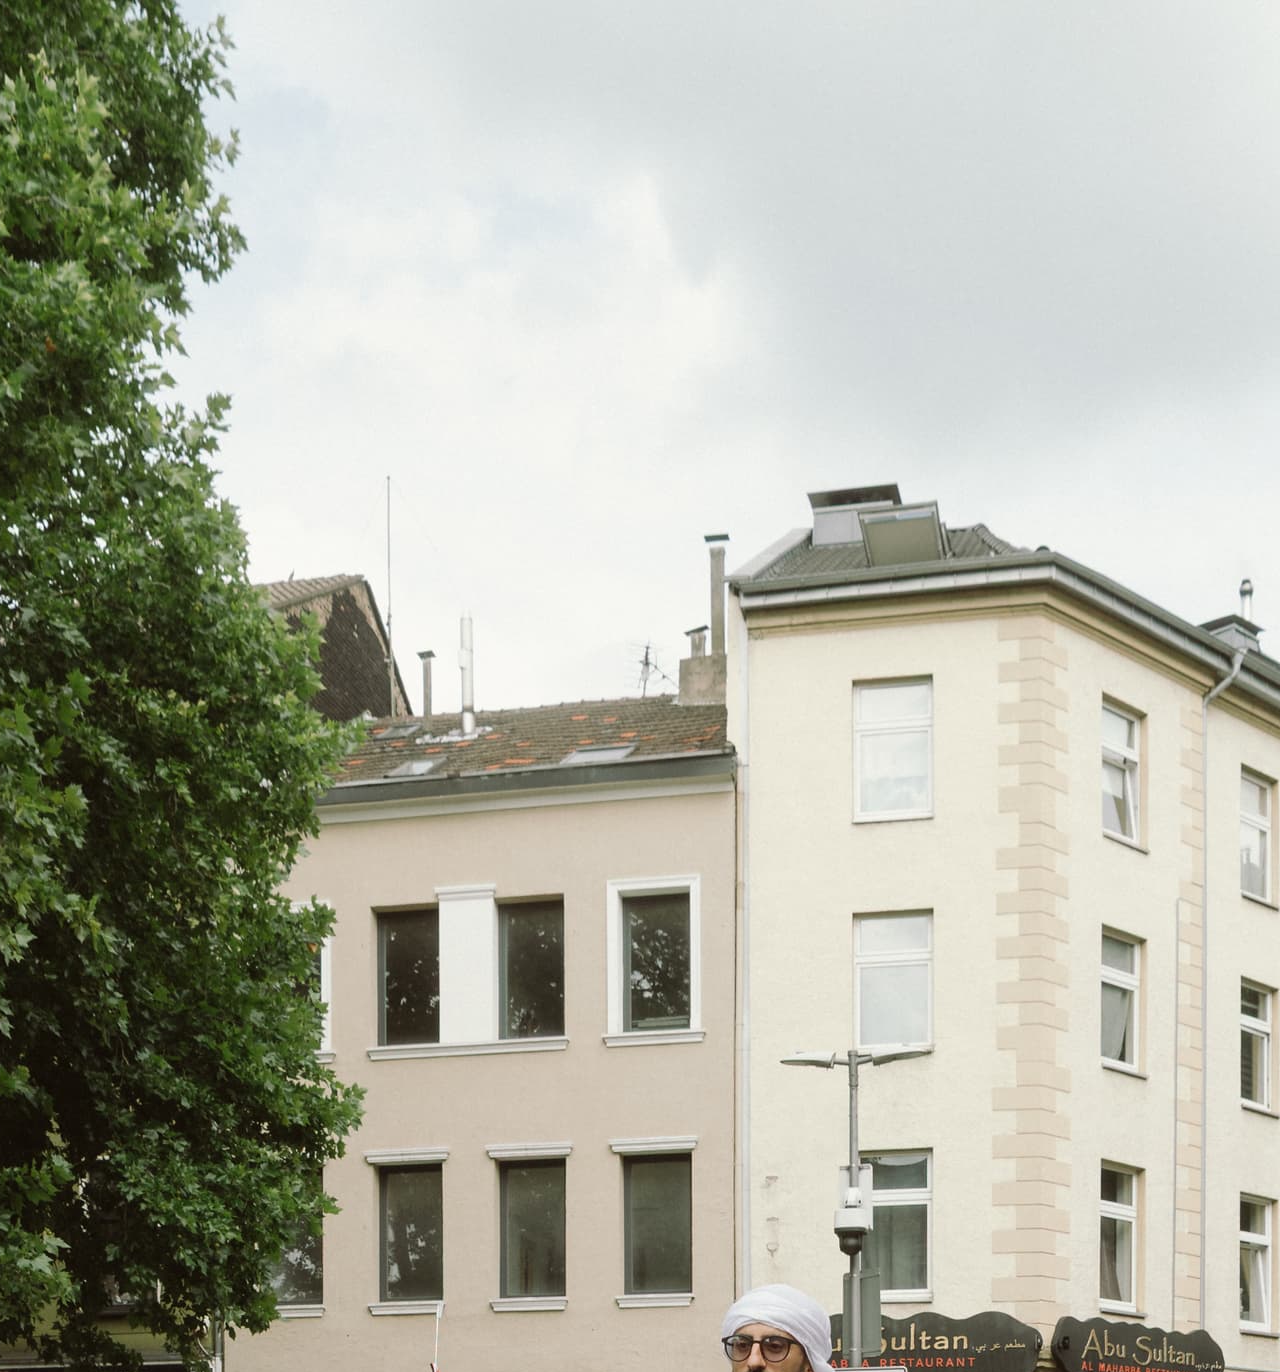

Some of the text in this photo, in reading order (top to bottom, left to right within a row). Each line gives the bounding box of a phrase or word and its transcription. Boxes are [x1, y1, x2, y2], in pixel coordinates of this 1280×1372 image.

[1081, 1328, 1196, 1366] Abu Sultan
[879, 1357, 977, 1368] RESTAURANT
[1081, 1360, 1094, 1371] AL
